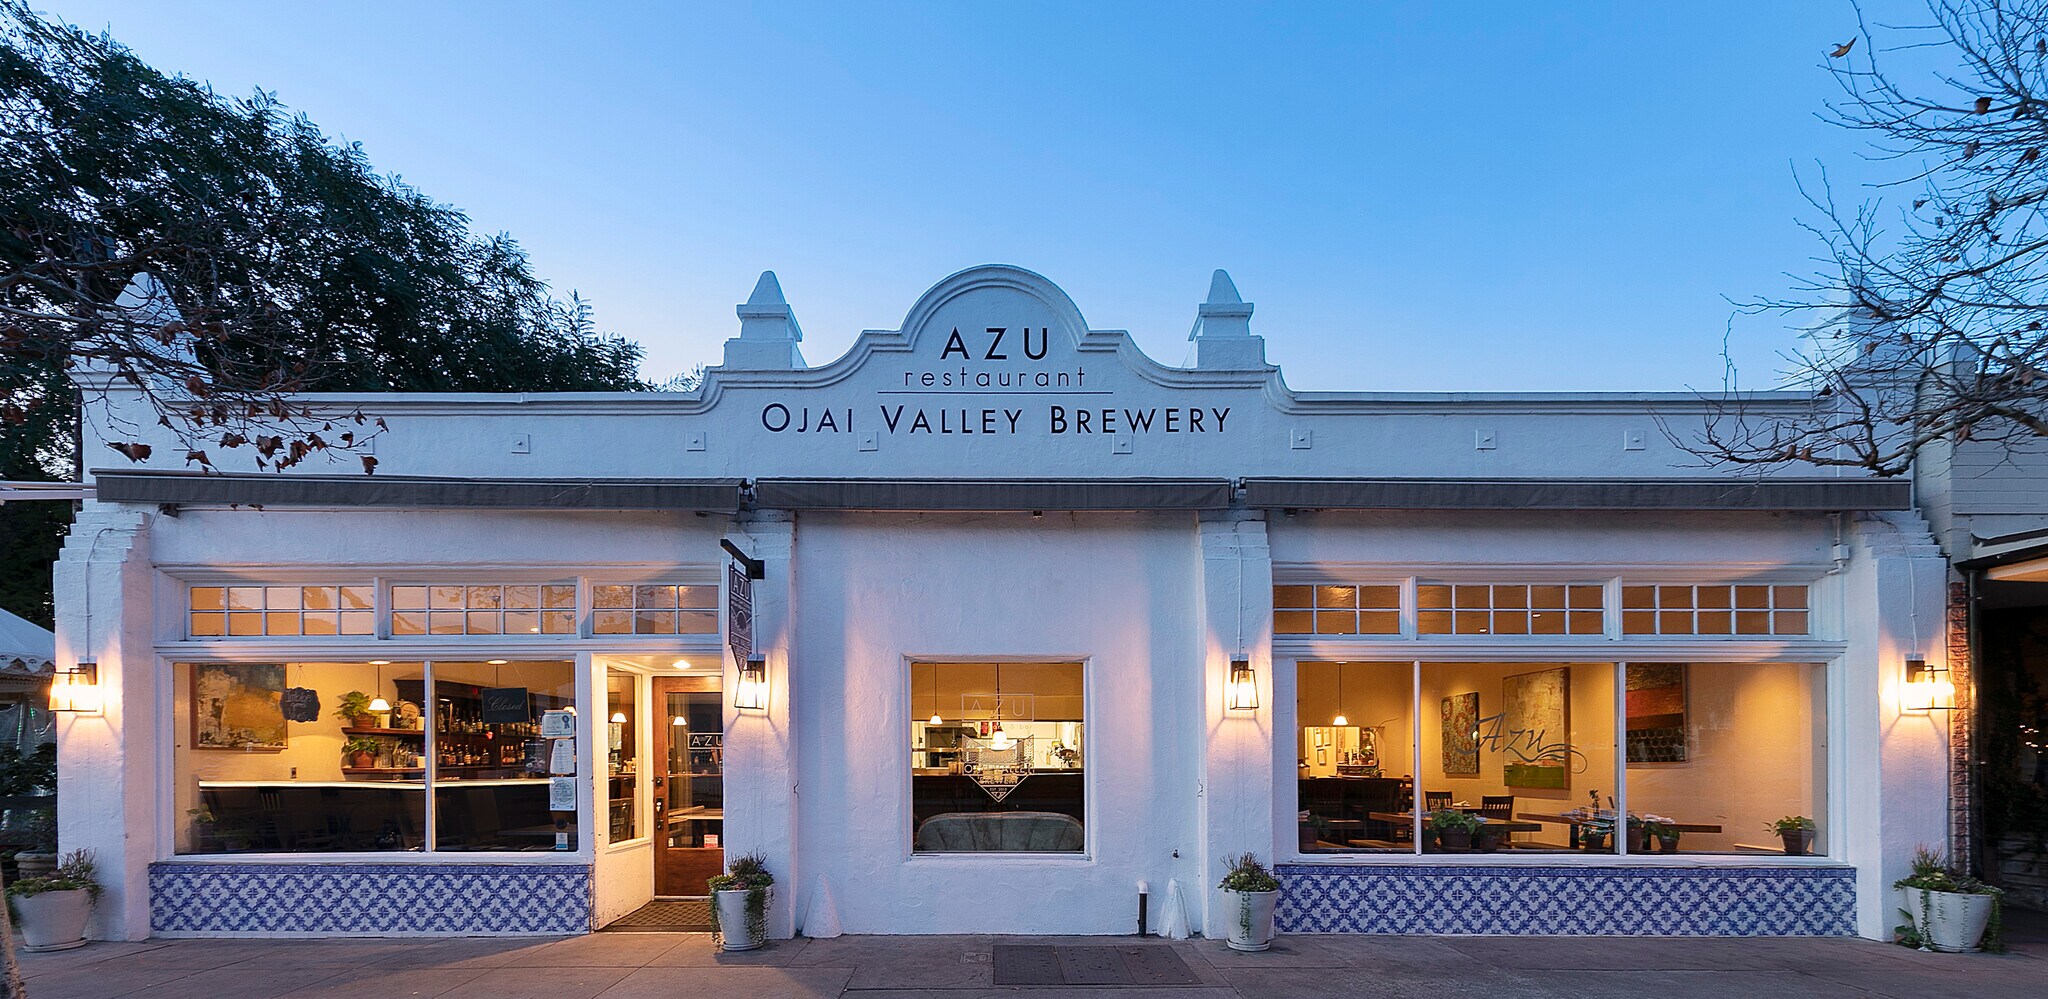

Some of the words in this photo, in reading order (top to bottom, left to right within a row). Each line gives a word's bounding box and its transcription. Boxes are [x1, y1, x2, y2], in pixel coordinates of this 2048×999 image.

[940, 326, 1048, 360] AZU
[904, 367, 1085, 387] restaurant
[761, 403, 853, 432] OJAI
[880, 405, 1022, 434] VALLEY
[1050, 405, 1231, 434] BREWERY
[733, 574, 750, 600] AZU
[487, 696, 525, 712] Closed
[969, 698, 1026, 717] AZU
[691, 735, 723, 747] AZU
[1453, 712, 1587, 774] Azu
